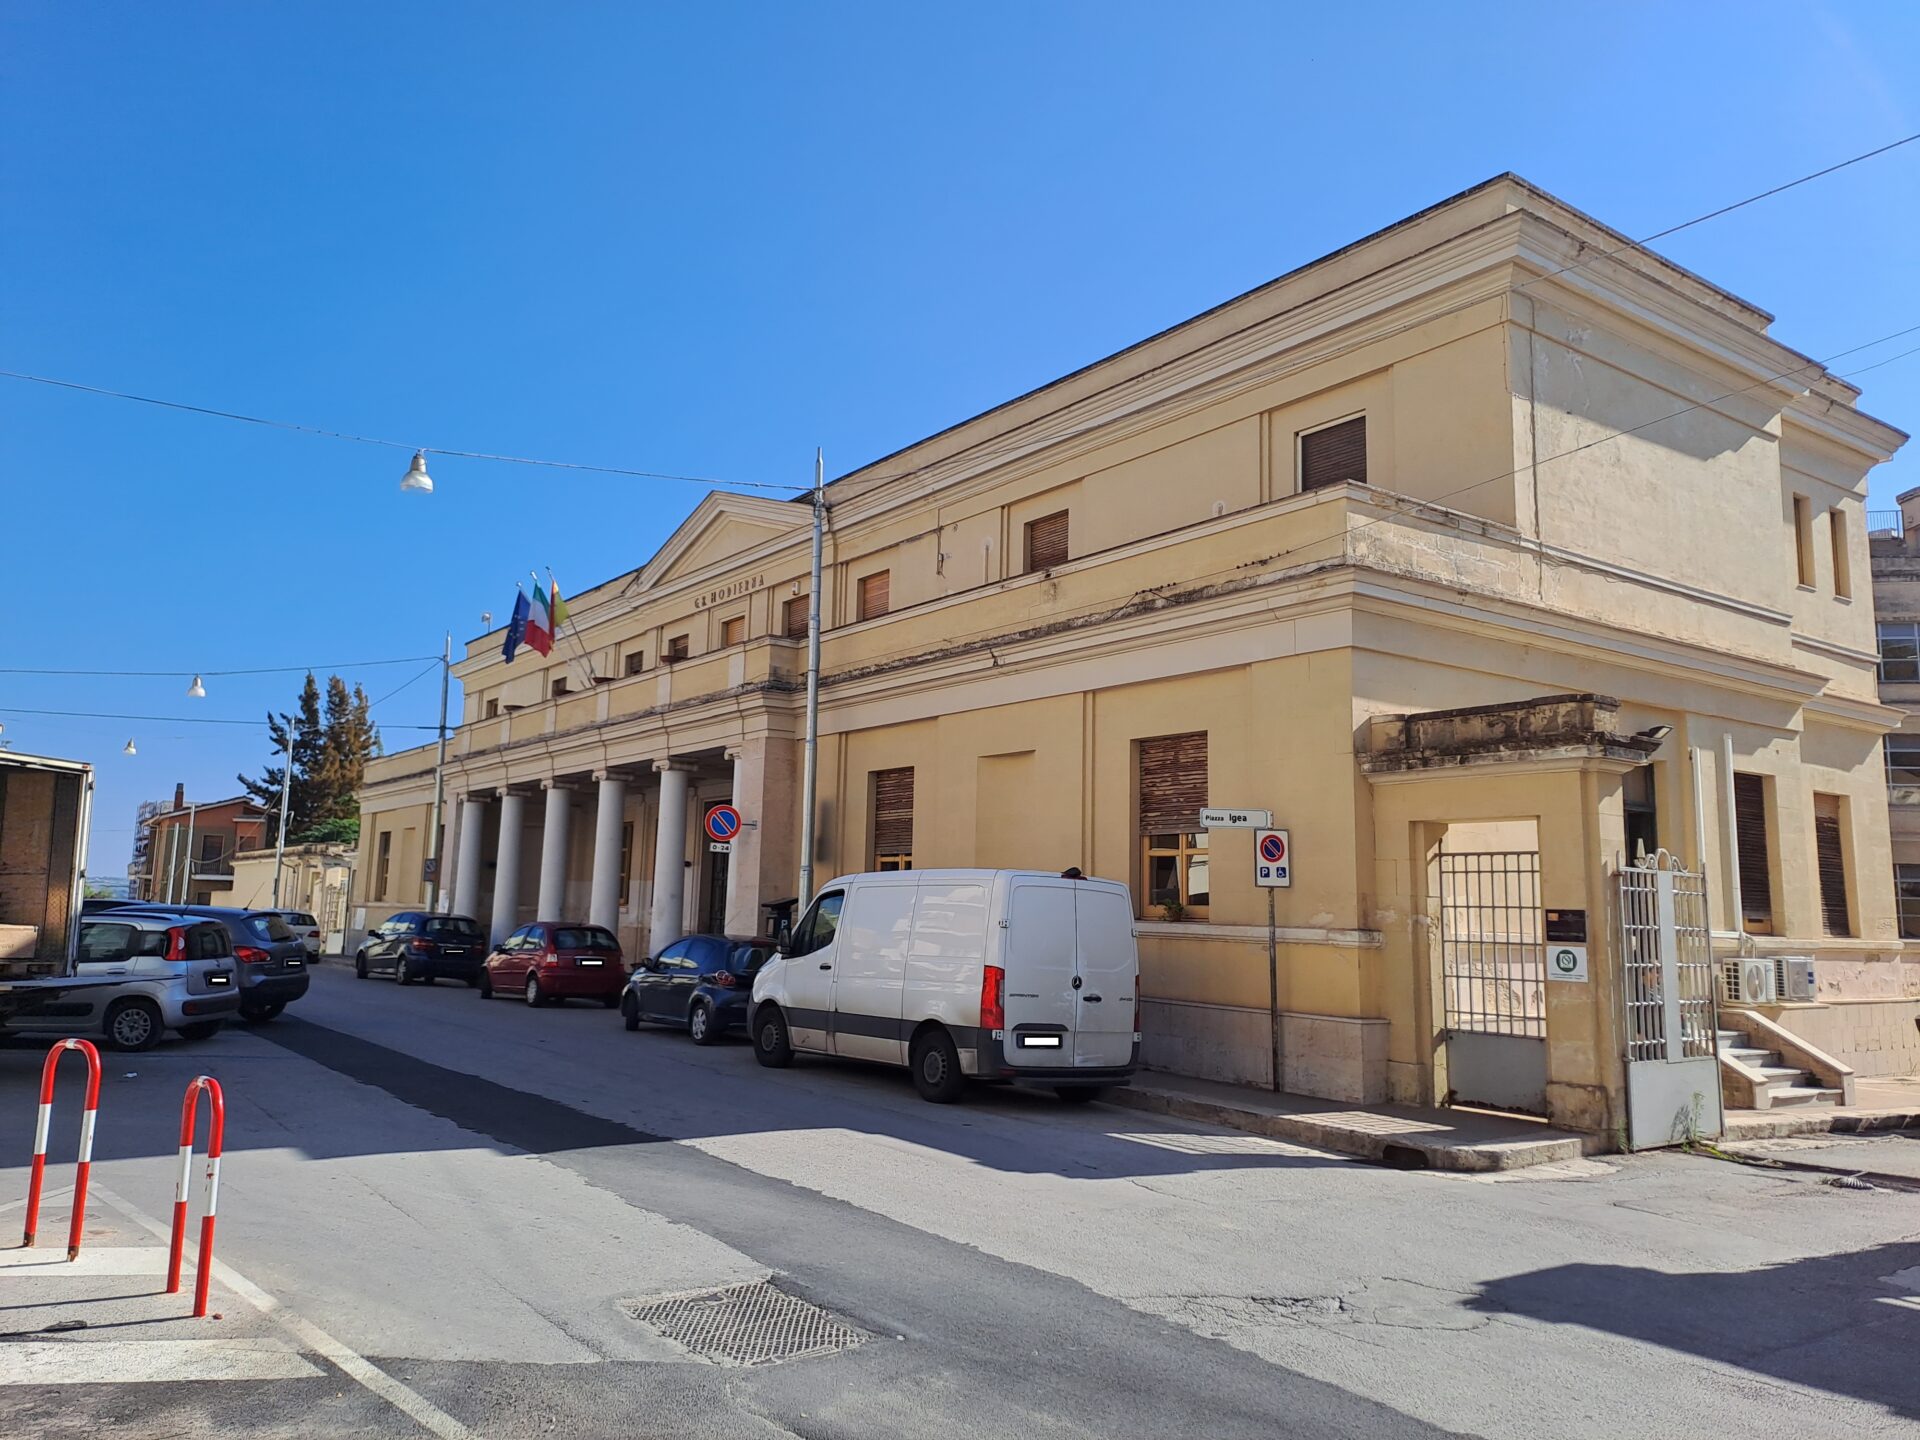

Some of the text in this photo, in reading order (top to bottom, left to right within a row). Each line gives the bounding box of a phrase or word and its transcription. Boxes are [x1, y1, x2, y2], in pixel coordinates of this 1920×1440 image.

[711, 574, 764, 603] HODIERNA
[1205, 813, 1247, 824] Piazza Igea
[1262, 867, 1269, 877] P
[781, 920, 788, 929] P
